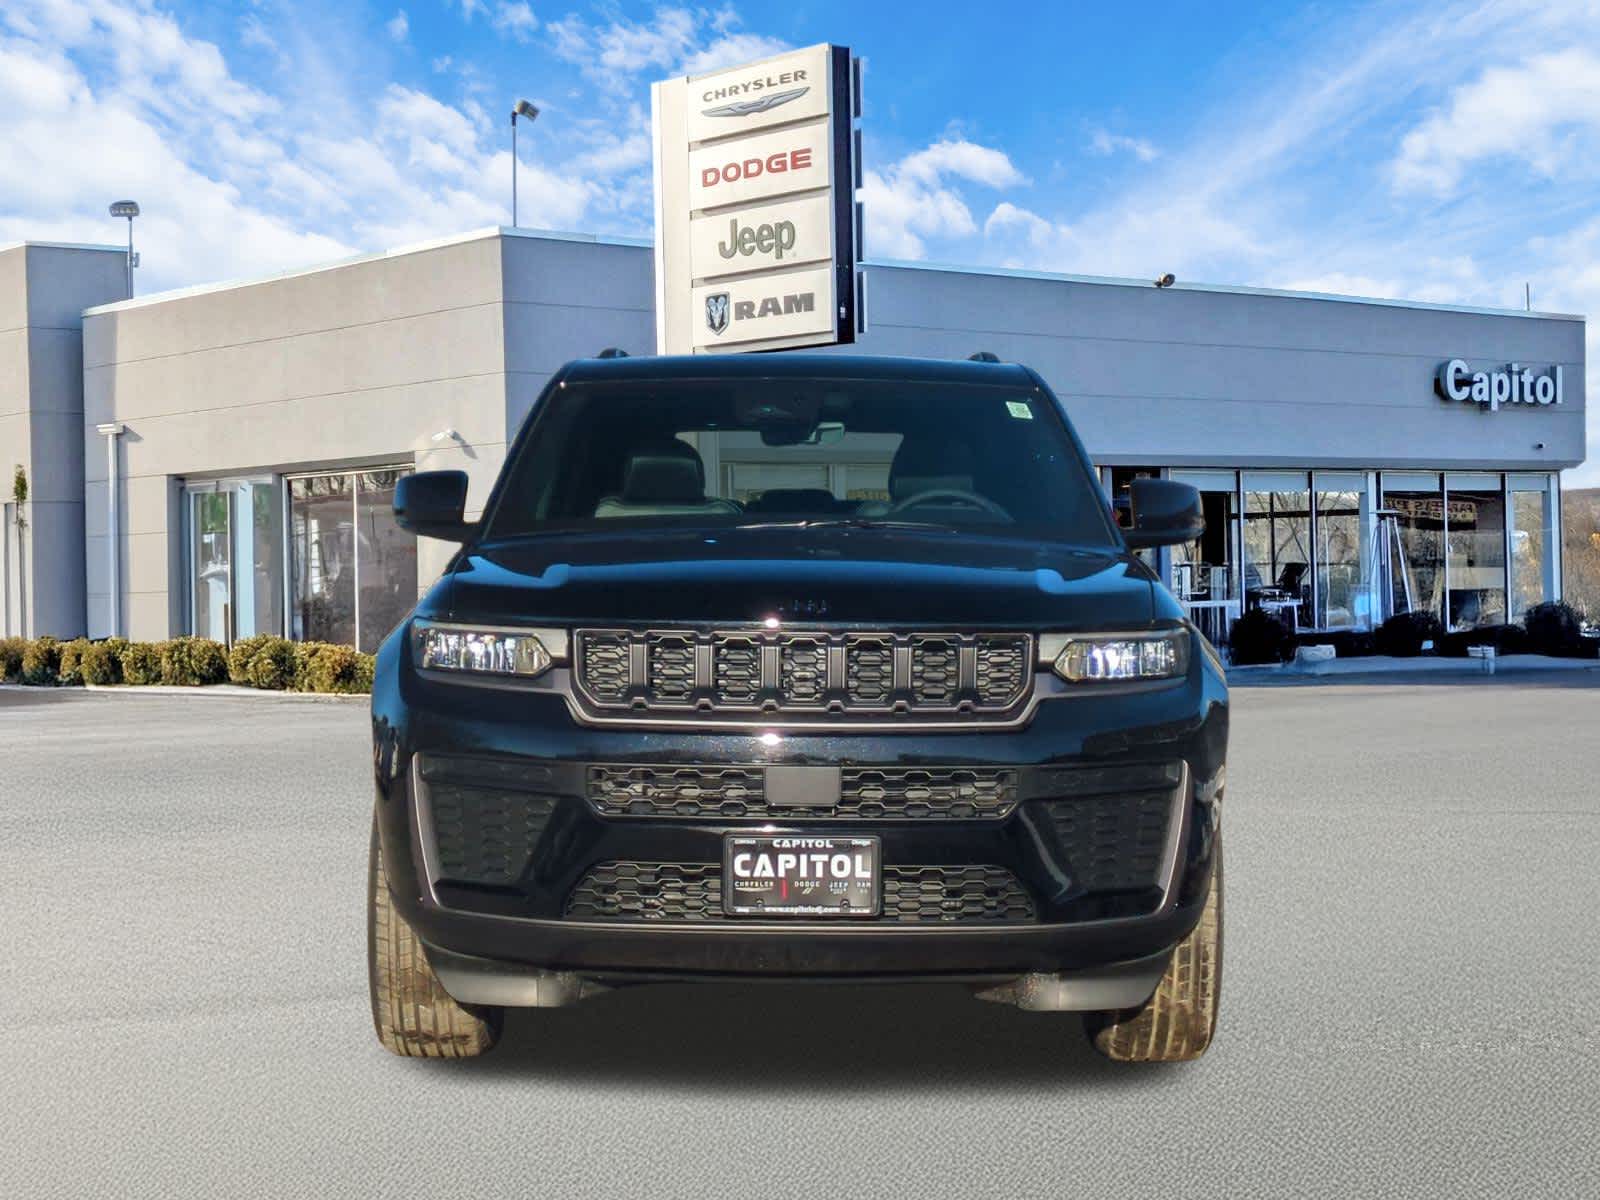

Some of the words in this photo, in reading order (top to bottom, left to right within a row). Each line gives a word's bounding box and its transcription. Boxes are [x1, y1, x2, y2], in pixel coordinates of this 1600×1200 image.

[702, 69, 808, 102] CHRYSLER
[702, 148, 812, 188] DODGE
[717, 218, 796, 260] Jeep
[734, 292, 815, 321] RAM
[1446, 359, 1563, 412] Capitol
[772, 839, 834, 849] CAPITOL
[734, 853, 872, 878] CAPITOL
